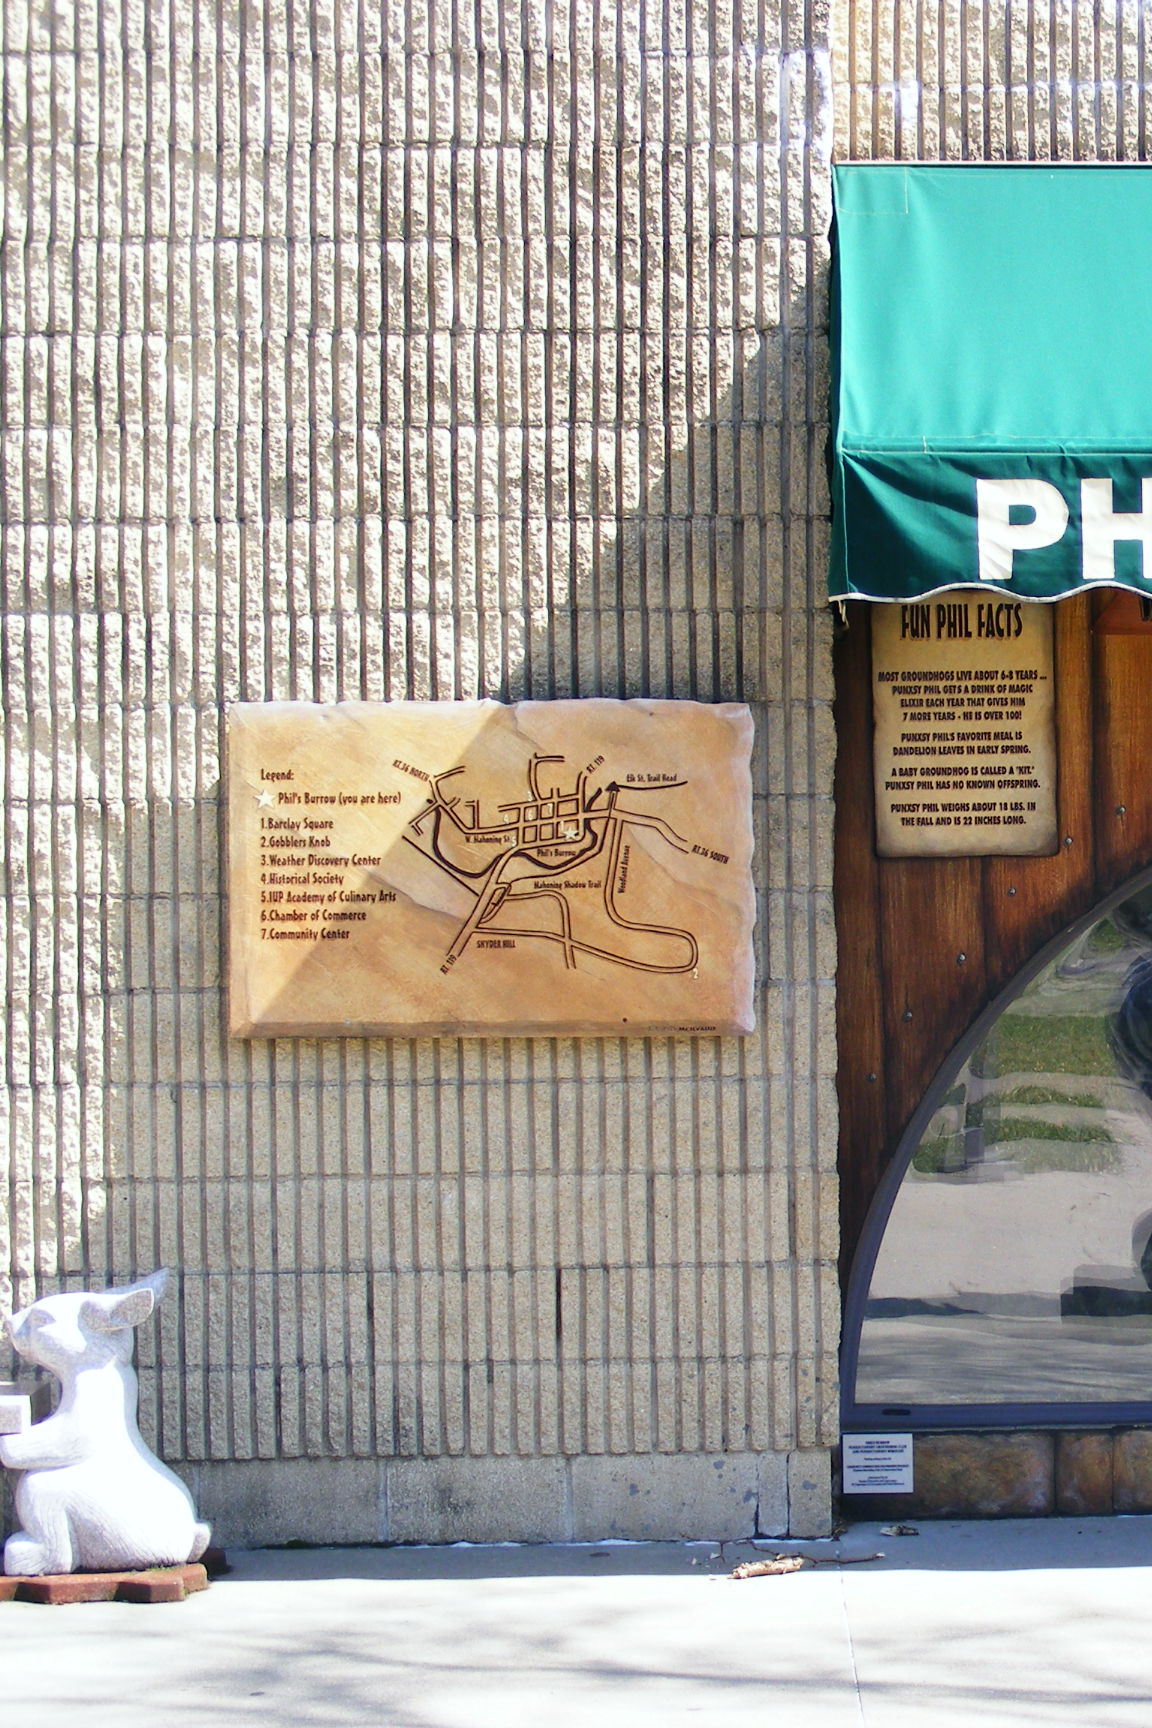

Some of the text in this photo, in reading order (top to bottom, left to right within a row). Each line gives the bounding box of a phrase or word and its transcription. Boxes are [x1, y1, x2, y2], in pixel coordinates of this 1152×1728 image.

[901, 603, 1022, 638] FUN PHIL FACTS
[878, 670, 1037, 682] MOST GROUNDHOGS LIVE ABOUT 6-8 YEARS
[892, 684, 1033, 695] PUNXSY PHIL GETS A DRINK OF MAGIC
[900, 698, 1025, 707] ELIXIR EACH YEAR THAT GIVES HIM
[903, 713, 907, 721] 7
[934, 712, 955, 720] YEARS
[963, 712, 972, 720] HE
[975, 712, 981, 720] IS
[984, 711, 1003, 720] OVER
[1006, 711, 1021, 719] 100!
[901, 733, 930, 742] PUNXSY
[957, 732, 991, 741] FAVORITE
[993, 732, 1013, 740] MEAL
[1015, 732, 1022, 740] IS
[893, 745, 1031, 756] DANDELION LEAVES IN EARLY SPRING.
[892, 768, 896, 776] A
[899, 768, 917, 776] BABY
[920, 767, 969, 776] GROUNDHOG
[971, 767, 978, 775] IS
[981, 767, 1006, 775] CALLED
[1009, 766, 1014, 774] A
[886, 782, 914, 790] PUNXSY
[917, 782, 933, 790] PHIL
[936, 781, 950, 789] HAS
[953, 781, 964, 789] NO
[966, 781, 995, 789] KNOWN
[279, 792, 401, 805] Phil's Burrow (you are here)
[891, 804, 920, 812] PUNXSY
[923, 804, 939, 812] PHIL
[942, 803, 969, 811] WEIGHS
[972, 803, 996, 811] ABOUT
[1027, 802, 1036, 810] IN
[304, 818, 333, 829] Square
[901, 818, 914, 826] THE
[917, 817, 933, 825] FALL
[936, 817, 951, 825] AND
[954, 817, 960, 825] IS
[975, 816, 1000, 824] INCHES
[309, 836, 330, 847] Knob
[308, 854, 349, 866] Discovery
[352, 854, 381, 866] Center
[313, 872, 344, 885] Society
[287, 891, 325, 904] Academy
[327, 891, 337, 902] of
[340, 891, 376, 902] Culinary
[379, 890, 396, 902] Arts
[311, 910, 319, 920] of
[323, 909, 366, 920] Commerce
[321, 928, 350, 938] Center
